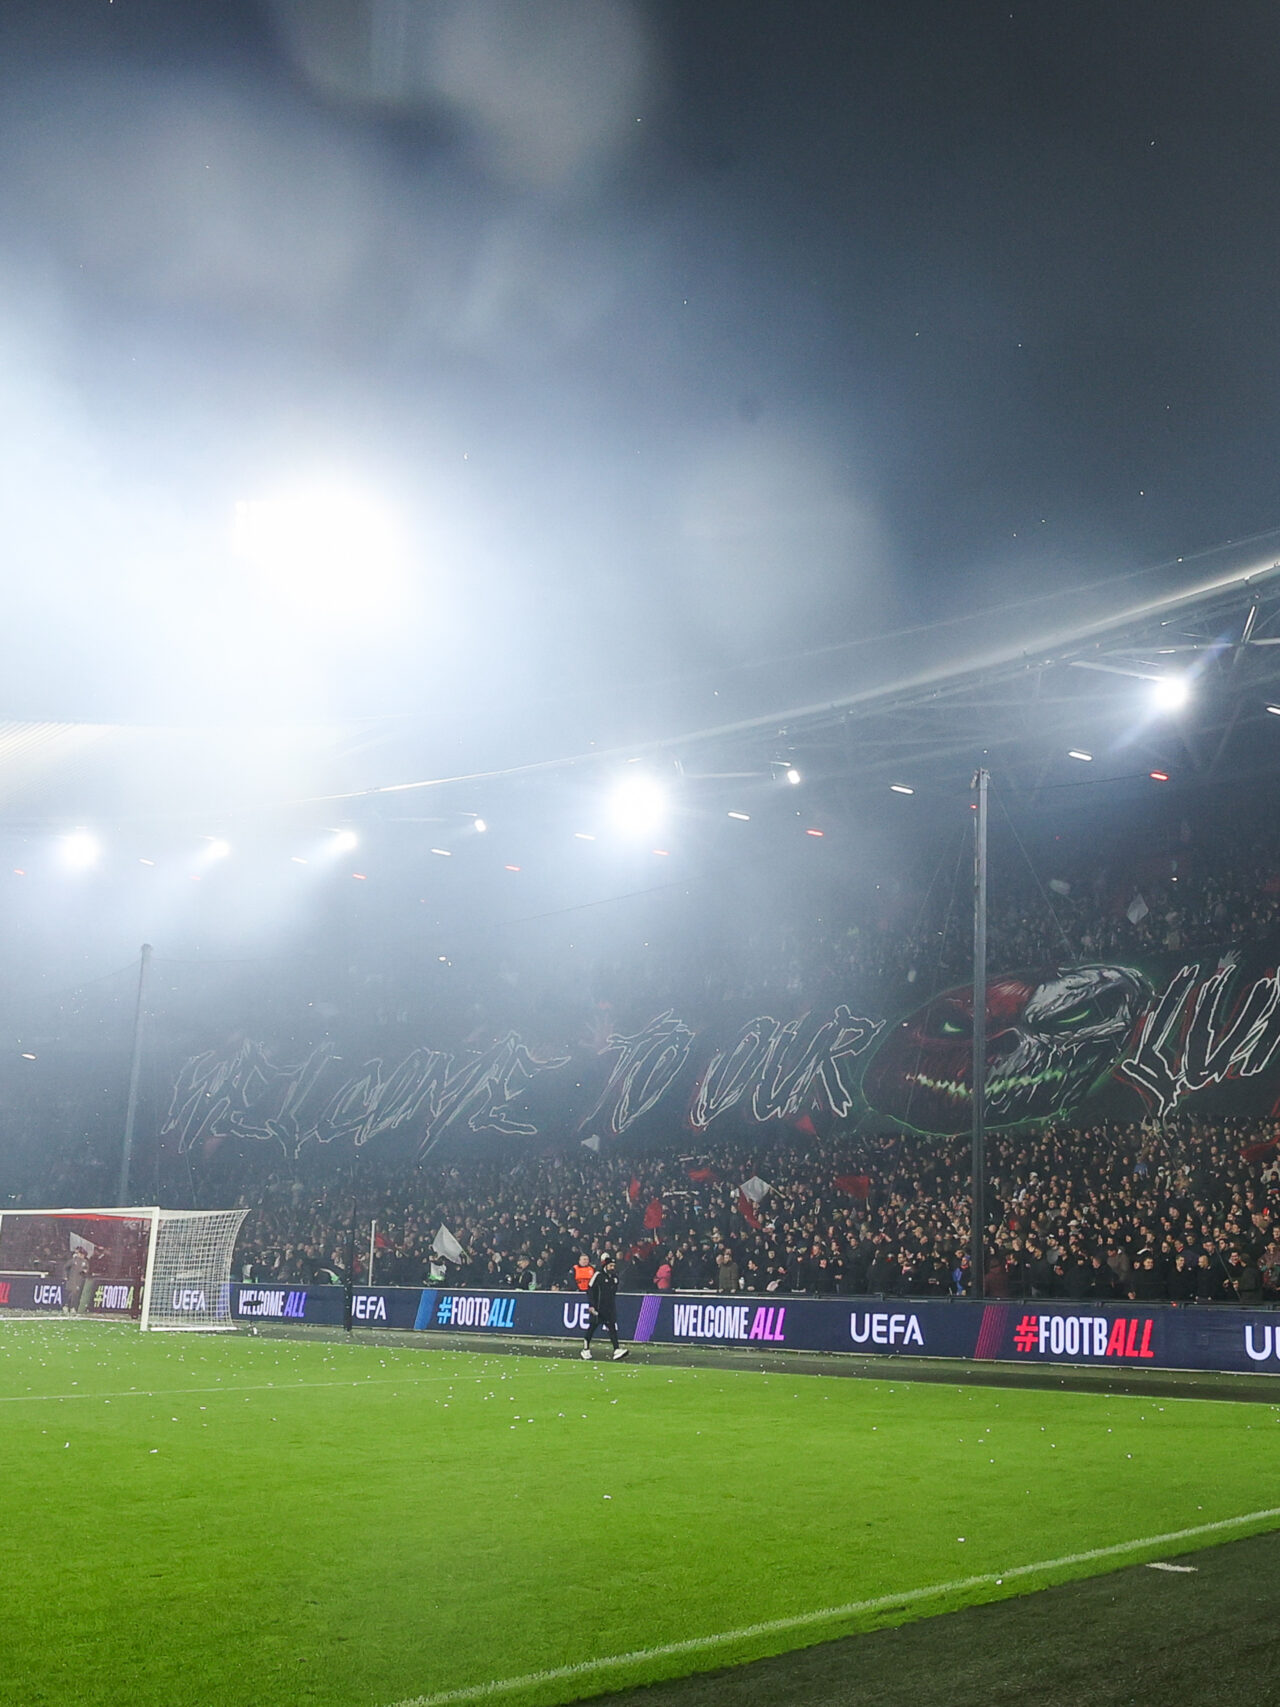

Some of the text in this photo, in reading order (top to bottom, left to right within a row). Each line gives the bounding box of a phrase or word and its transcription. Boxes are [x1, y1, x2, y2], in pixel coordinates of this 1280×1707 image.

[577, 1007, 696, 1134] TO
[690, 1004, 887, 1132] OUR
[34, 1285, 62, 1305] UEFA
[172, 1289, 207, 1312] UEFA
[238, 1289, 307, 1317] WELCOME ALL
[437, 1296, 516, 1328] #FOOTBALL
[563, 1302, 619, 1331] UE
[673, 1304, 786, 1341] WELCOME ALL
[850, 1312, 925, 1346] UEFA
[1013, 1314, 1155, 1359] #FOOTBALL
